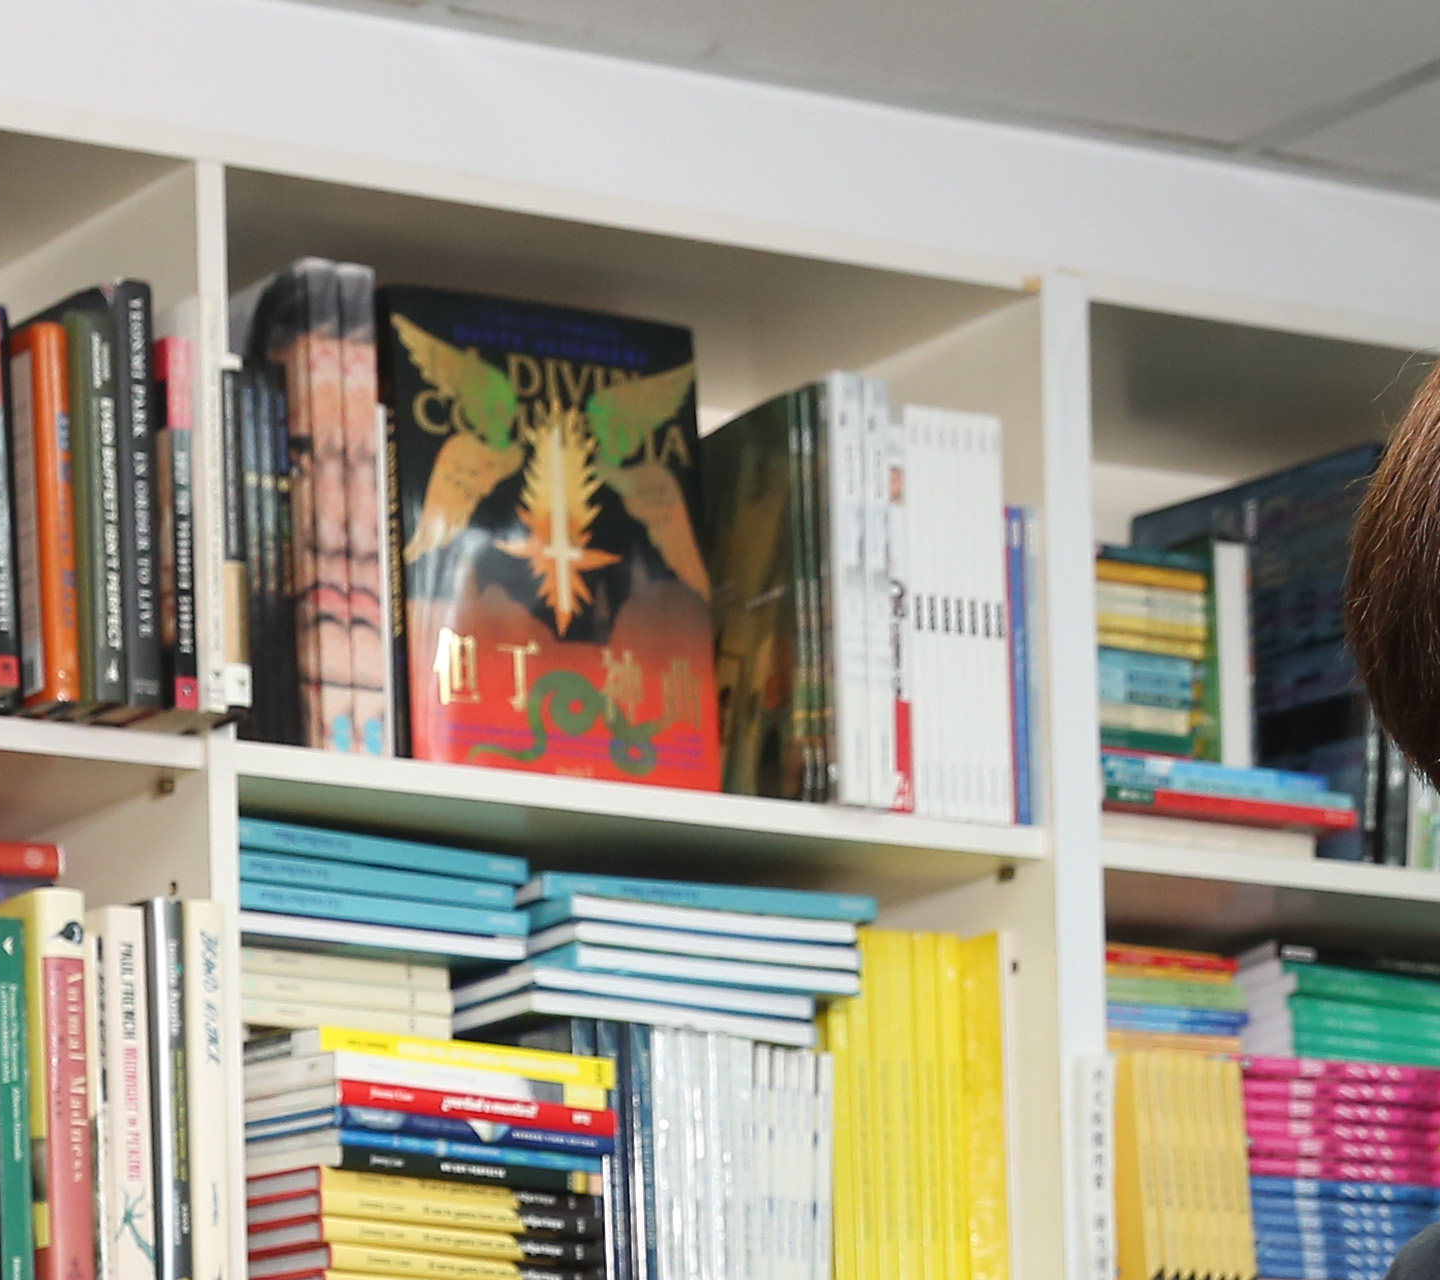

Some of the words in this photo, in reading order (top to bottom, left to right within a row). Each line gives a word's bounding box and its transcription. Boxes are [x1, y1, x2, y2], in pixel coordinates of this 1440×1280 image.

[99, 397, 114, 445] EVEN
[132, 384, 148, 438] PARK
[100, 447, 116, 521] BUFFETT
[133, 451, 148, 475] IN
[134, 478, 151, 552] ORDER
[102, 522, 118, 567] ISN'T
[136, 557, 151, 584] TO
[104, 569, 121, 650] PERFECT
[137, 589, 154, 639] LIVE
[120, 943, 137, 978] PAUL
[67, 966, 86, 1062] Animal
[121, 982, 139, 1041] FRENCH
[122, 1047, 141, 1113] MIDNIGHT
[68, 1076, 87, 1186] Madness
[124, 1131, 143, 1182] PEKING
